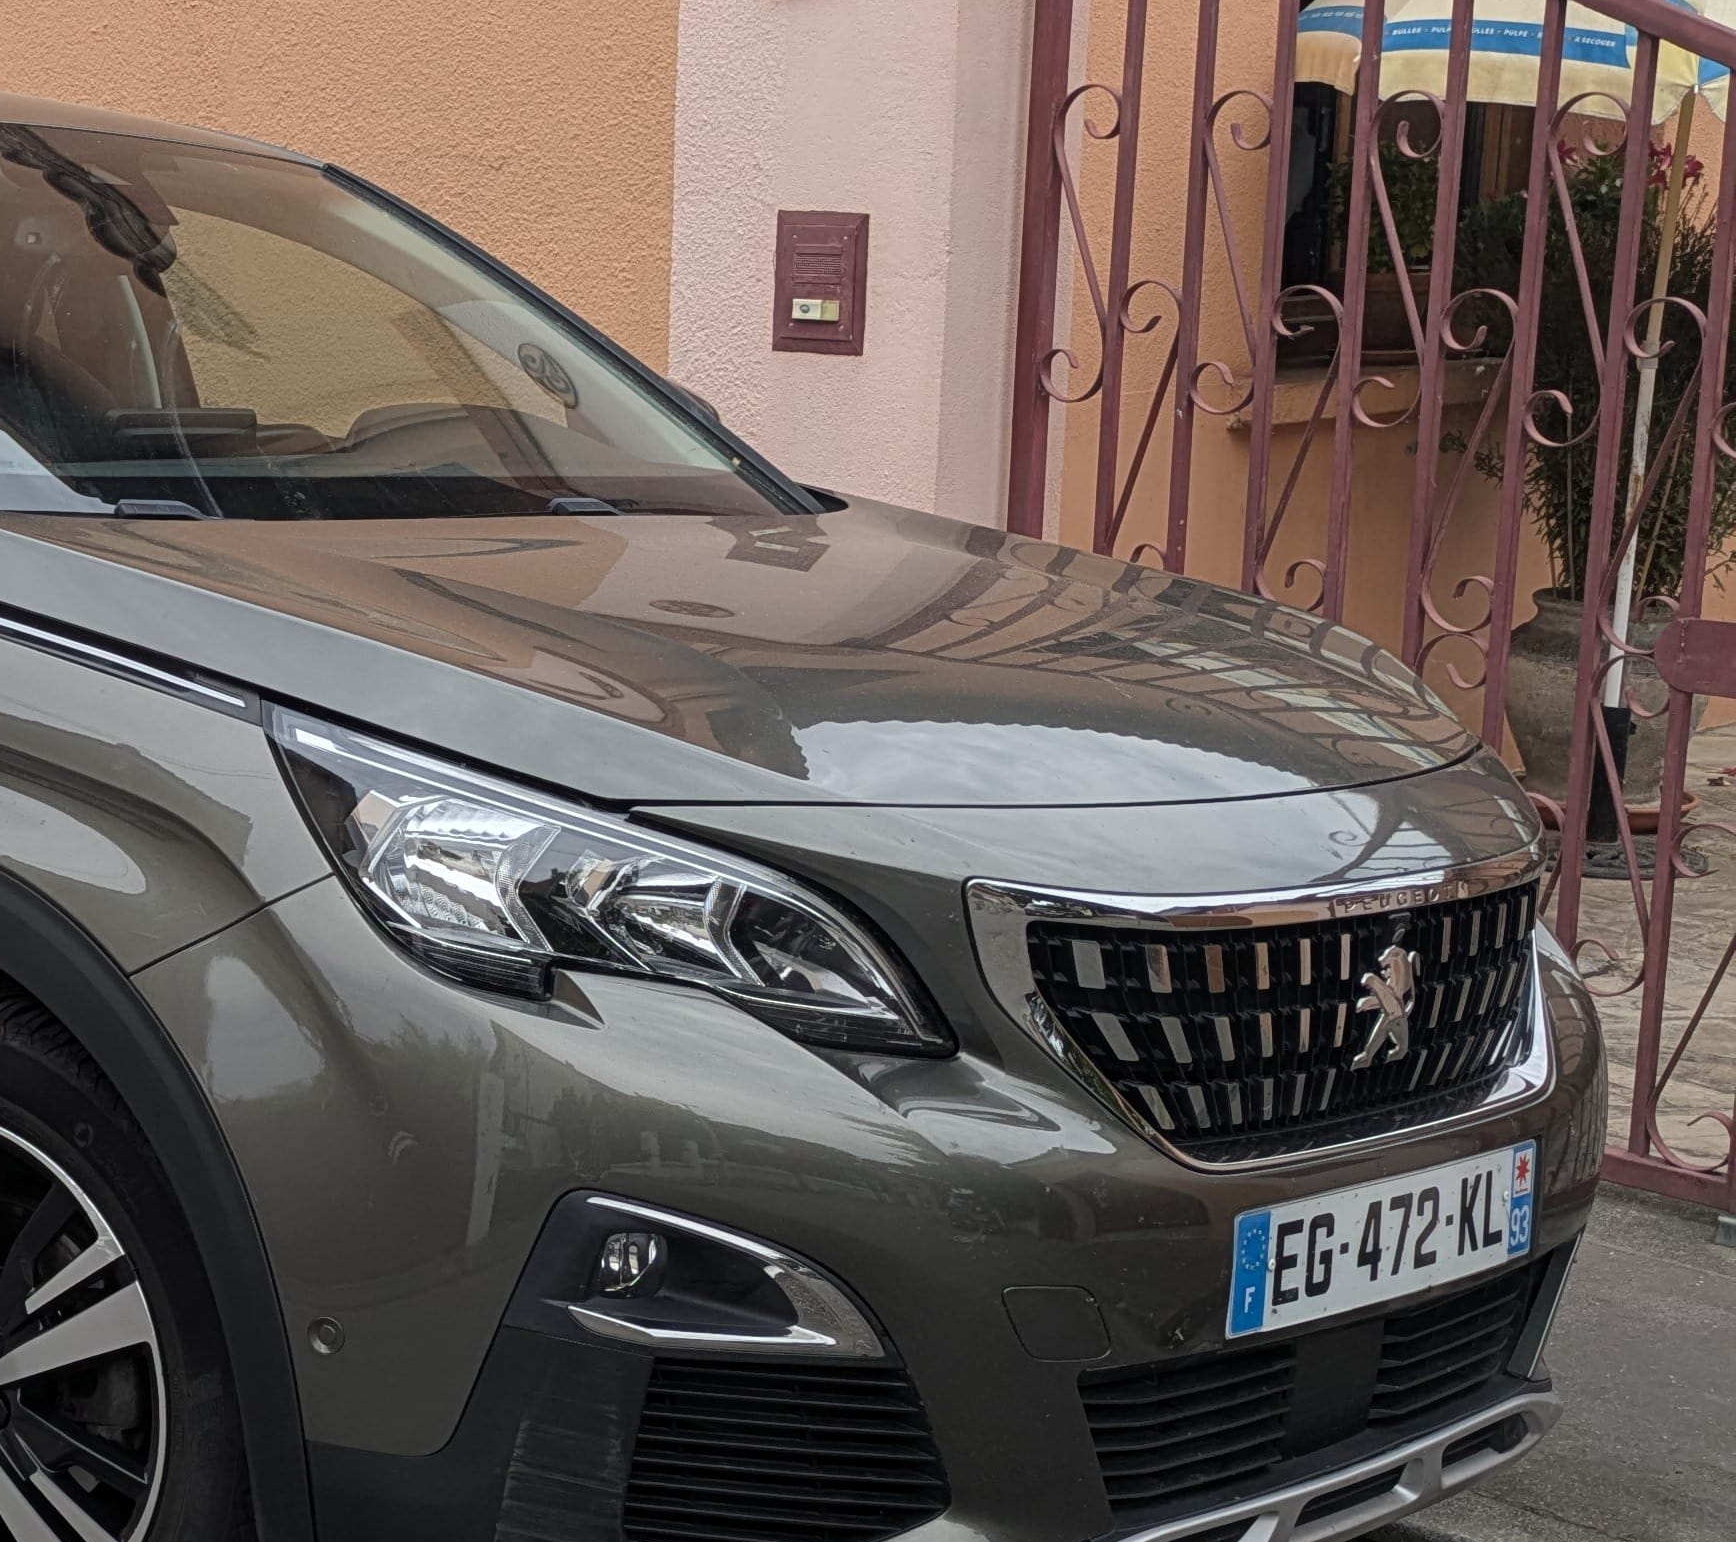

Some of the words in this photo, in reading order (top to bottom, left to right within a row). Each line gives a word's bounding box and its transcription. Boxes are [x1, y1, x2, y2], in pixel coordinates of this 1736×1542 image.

[1392, 27, 1421, 36] BULLES
[1431, 26, 1452, 34] PULP
[1503, 28, 1528, 38] PULPE
[1581, 37, 1616, 47] SECOUER
[1343, 885, 1456, 914] PEUGEOT
[1243, 1286, 1257, 1314] F
[1271, 1170, 1503, 1306] EG-472-KL
[1509, 1204, 1530, 1246] 93
